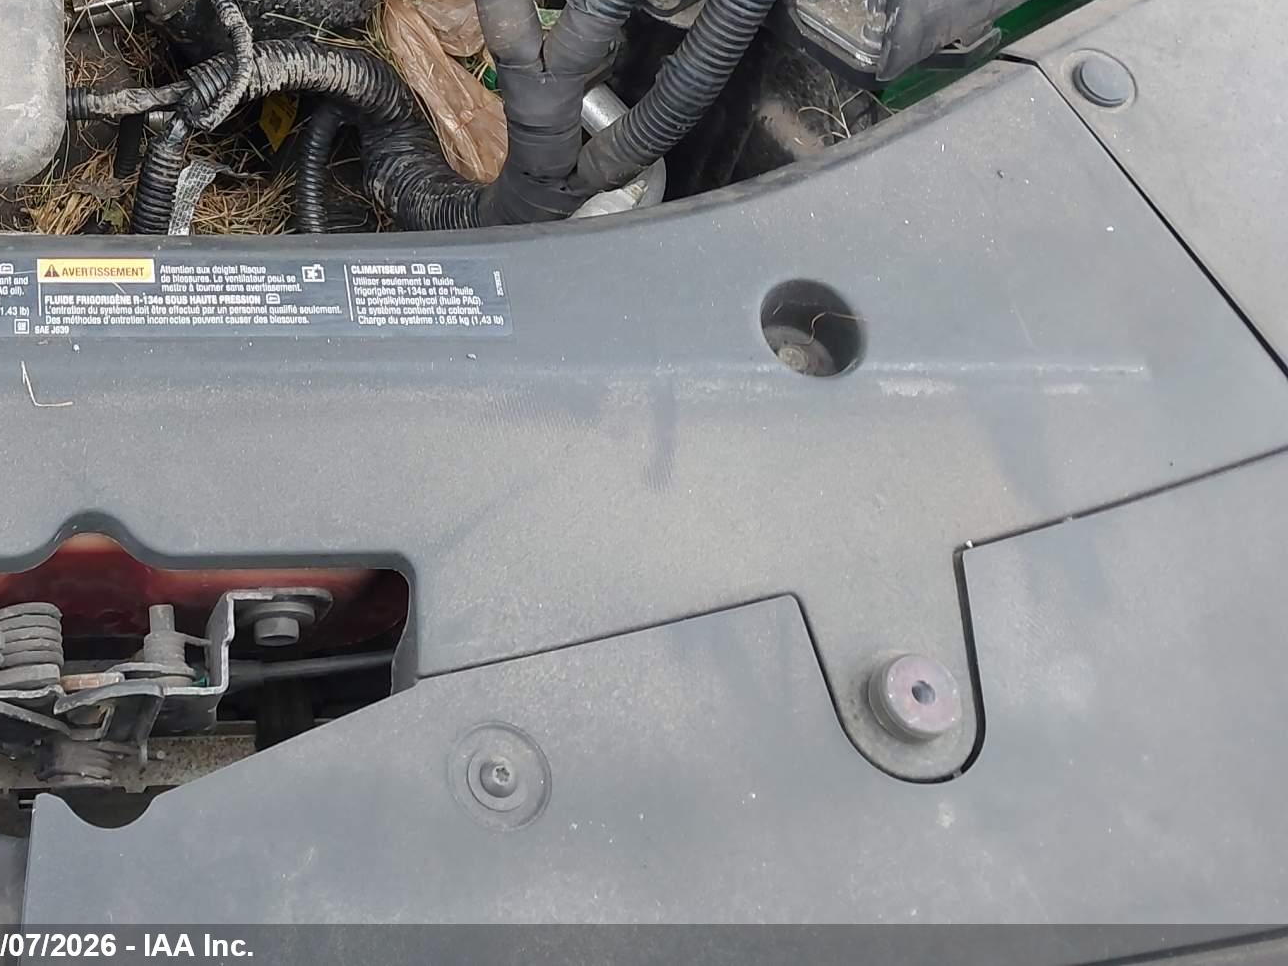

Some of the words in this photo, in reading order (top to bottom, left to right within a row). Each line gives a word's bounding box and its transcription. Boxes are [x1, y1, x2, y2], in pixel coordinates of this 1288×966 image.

[62, 267, 145, 277] AVERTISSEMENT
[351, 265, 407, 275] CLIMATISEUR
[14, 276, 29, 285] and
[398, 286, 427, 296] R-134a
[45, 295, 74, 304] FLUIDE
[133, 295, 163, 304] R-134a
[165, 295, 188, 304] SOUS
[190, 295, 218, 304] HAUTE
[219, 295, 261, 304] PRESSION
[437, 306, 446, 315] du
[388, 316, 399, 324] du
[460, 316, 469, 326] kg
[35, 326, 49, 334] SAE
